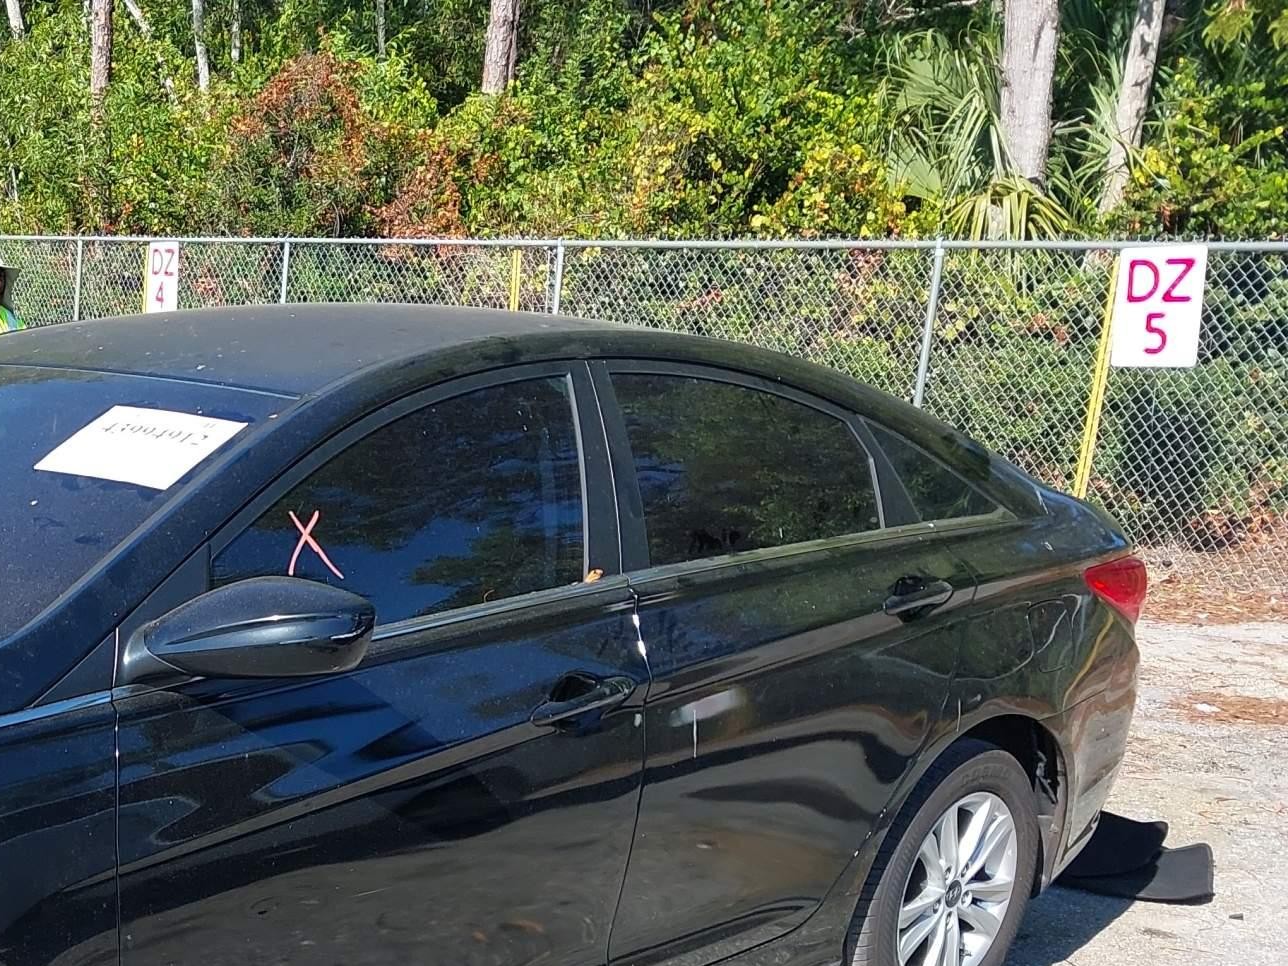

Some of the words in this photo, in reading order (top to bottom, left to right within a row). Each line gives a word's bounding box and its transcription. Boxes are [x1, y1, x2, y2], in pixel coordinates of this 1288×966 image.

[151, 248, 176, 276] DZ
[1126, 257, 1196, 303] DZ
[155, 281, 164, 309] 4
[1143, 311, 1167, 354] 5
[287, 509, 345, 580] X
